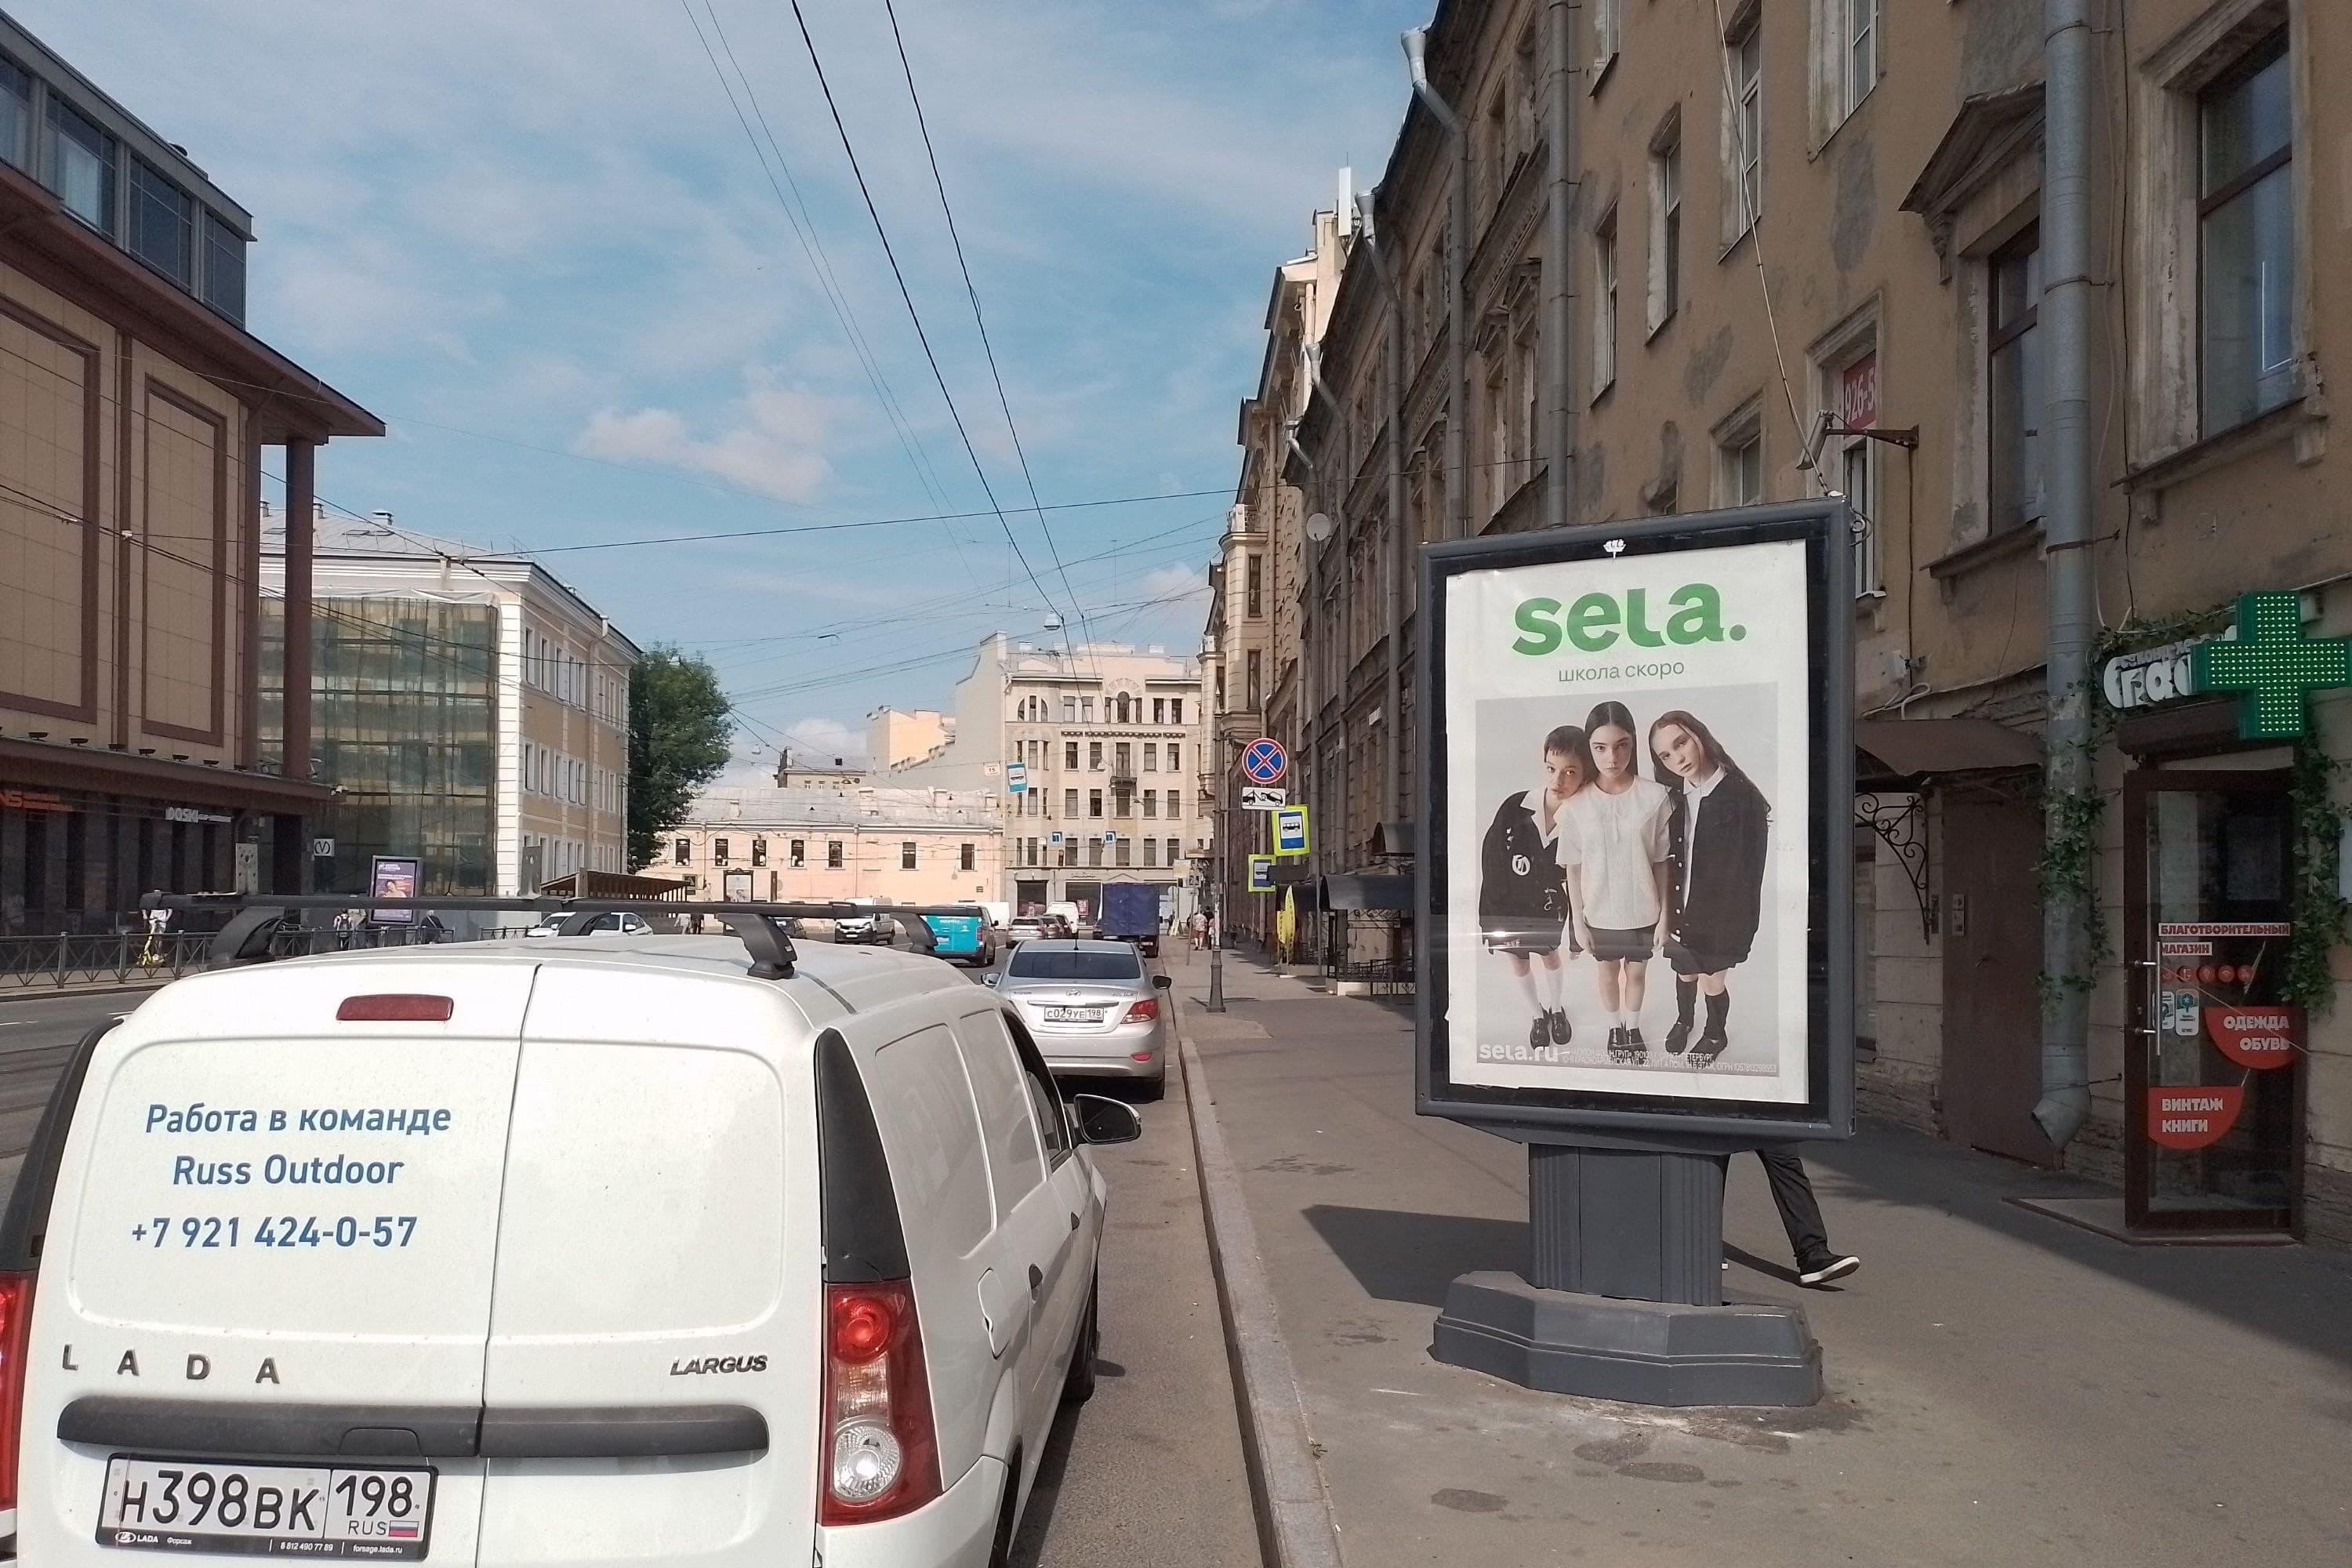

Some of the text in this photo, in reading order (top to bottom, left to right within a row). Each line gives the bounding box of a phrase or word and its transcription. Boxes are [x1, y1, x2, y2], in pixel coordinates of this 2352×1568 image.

[1559, 662, 1685, 682] школа скоро
[2161, 924, 2289, 935] БЛАГОТВОРИТЕЛЬНЫЙ
[2161, 943, 2209, 954] МАГАЗИН
[2223, 1015, 2289, 1030] ОДЕЖДА
[2240, 1037, 2289, 1051] ОБУВЬ
[1479, 1044, 1559, 1062] sela.ru
[2161, 1098, 2223, 1112] ВИНТАЖ
[146, 1102, 452, 1135] Работа в команде
[2161, 1119, 2209, 1133] КНИГИ
[172, 1153, 405, 1185] Russ Outdoor
[132, 1216, 418, 1248] +7 921 424-0-57
[62, 1345, 281, 1385] LADA
[670, 1355, 768, 1377] LARGUS
[119, 1469, 413, 1531] Н398ВК 198
[347, 1520, 387, 1536] RUS
[136, 1534, 159, 1543] LADA
